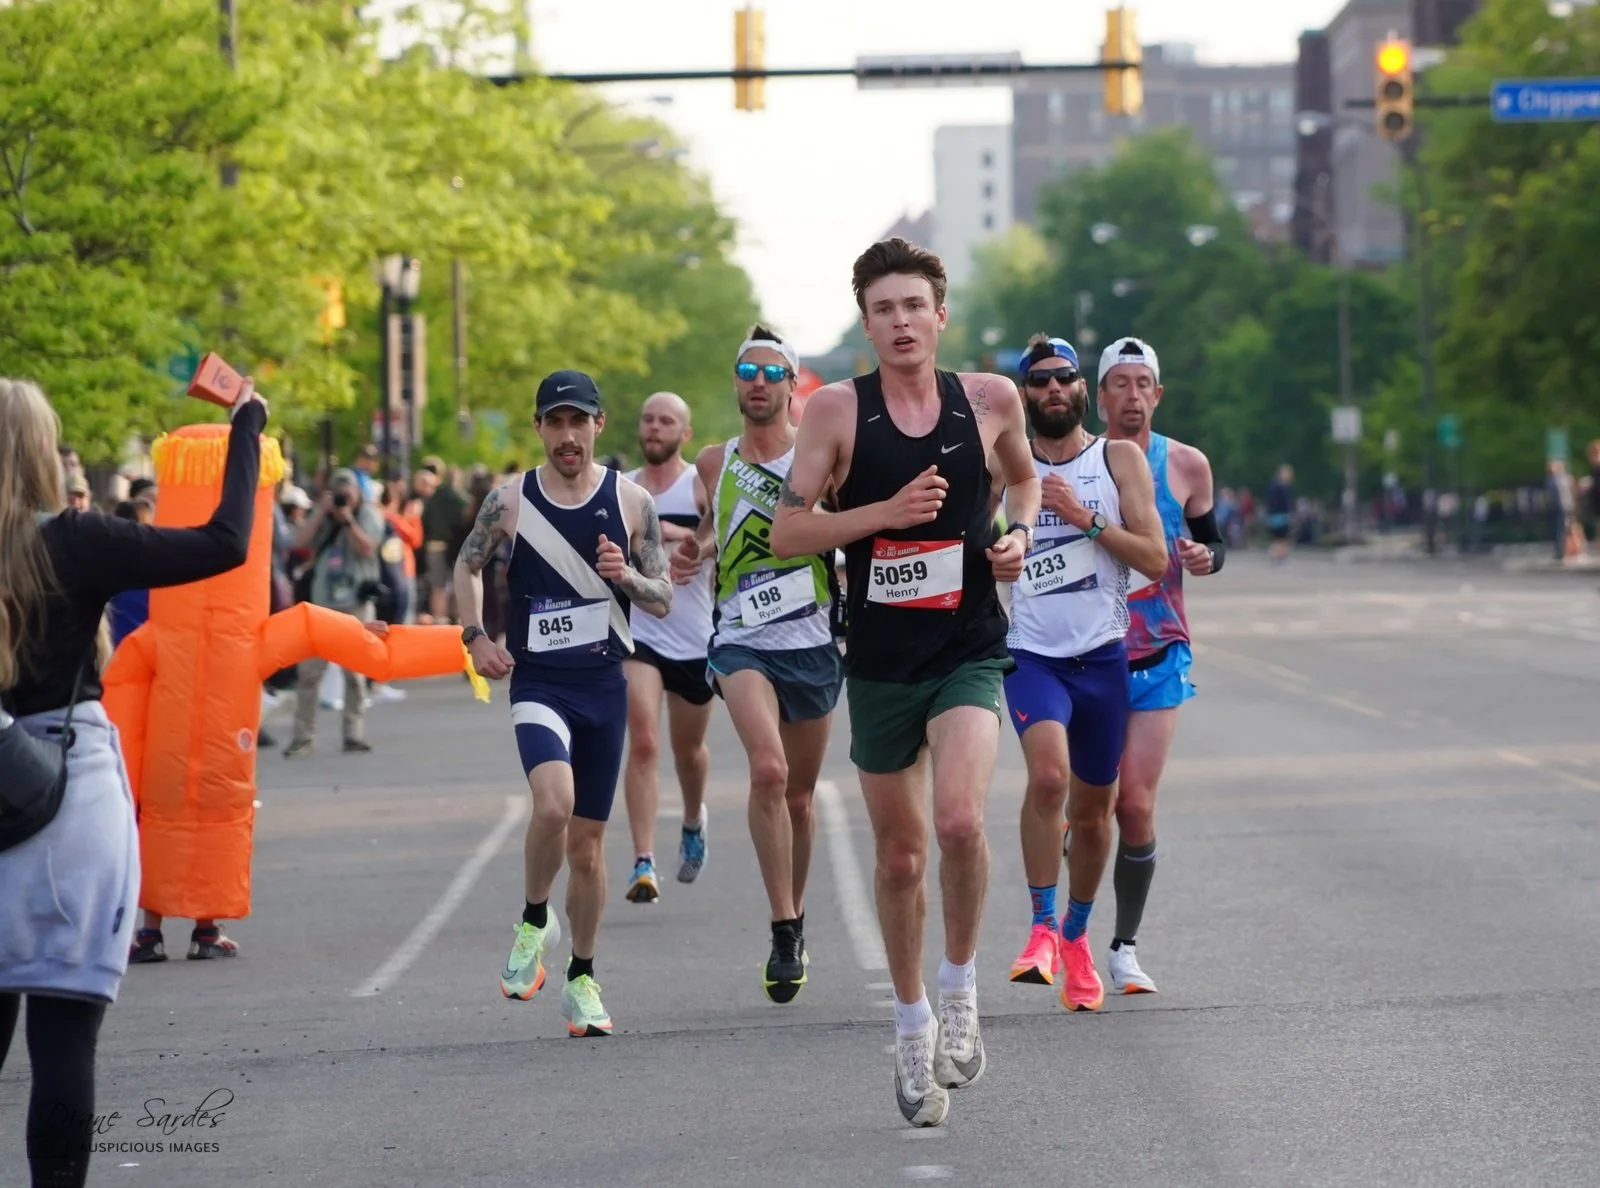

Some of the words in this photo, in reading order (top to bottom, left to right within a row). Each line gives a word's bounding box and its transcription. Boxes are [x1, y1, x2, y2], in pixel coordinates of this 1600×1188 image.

[735, 478, 778, 510] ONLIN
[874, 560, 928, 586] 5059
[1023, 553, 1066, 581] 1233
[1032, 575, 1064, 591] Woody
[748, 586, 782, 610] 198
[886, 587, 919, 598] Henry
[545, 600, 571, 610] MARATHON
[758, 606, 782, 620] Ryan
[538, 615, 573, 636] 845
[547, 636, 570, 647] Josh
